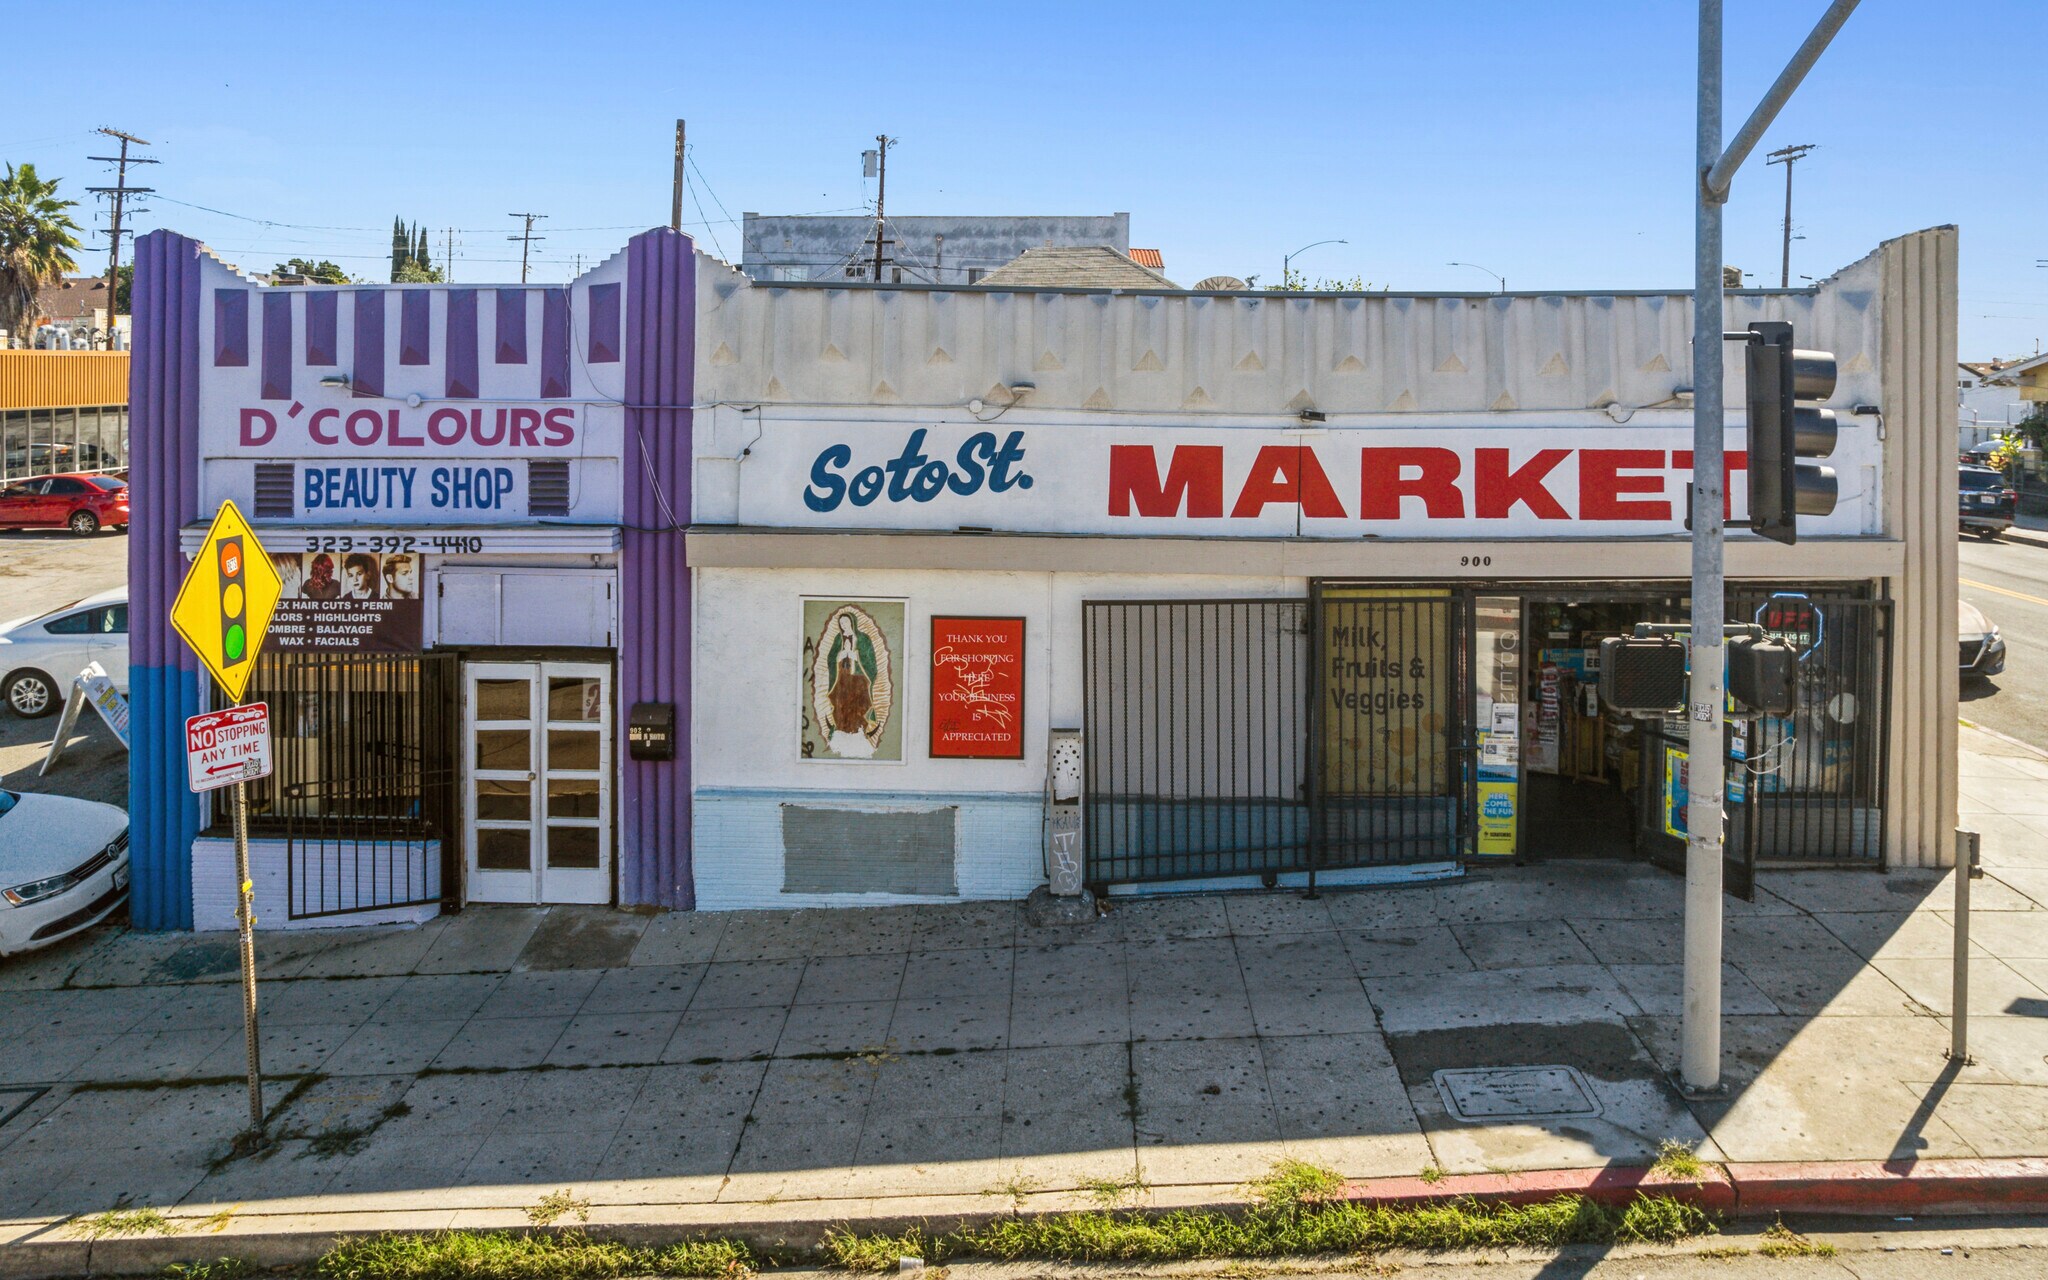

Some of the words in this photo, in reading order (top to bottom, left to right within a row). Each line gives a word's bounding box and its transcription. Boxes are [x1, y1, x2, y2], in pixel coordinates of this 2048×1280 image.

[239, 400, 575, 447] D'COLOURS
[803, 428, 948, 512] Soto
[948, 430, 1033, 496] St.
[304, 467, 417, 509] BEAUTY
[431, 467, 514, 510] SHOP
[305, 536, 484, 553] 323-392-4410
[1460, 556, 1491, 567] 900
[275, 601, 290, 610] EX
[292, 601, 319, 610] HAIR
[322, 601, 351, 610] CUTS
[362, 601, 393, 610] PERM
[270, 613, 303, 622] OLORS
[313, 613, 382, 622] HIGHLIGHTS
[1768, 611, 1811, 629] UFC
[268, 625, 306, 634] OMBRE
[316, 625, 373, 634] BALAYAGE
[279, 637, 304, 646] WAX
[315, 637, 360, 646] FACIALS
[946, 634, 983, 643] THANK
[986, 634, 1007, 643] YOU
[1332, 626, 1386, 651] Milk,
[940, 654, 960, 663] FOR
[962, 654, 1014, 663] SHOPPING
[1587, 657, 1600, 668] EB
[1332, 657, 1402, 678] Fruits
[1409, 657, 1425, 679] &
[938, 692, 967, 701] YOUR
[969, 693, 1016, 701] BUSINESS
[1331, 688, 1425, 715] Veggies
[972, 713, 981, 721] IS
[190, 729, 214, 750] NO
[218, 721, 266, 743] STOPPING
[942, 733, 1011, 741] APPRECIATED
[201, 748, 226, 764] ANY
[231, 741, 260, 757] TIME
[1488, 792, 1508, 800] HERE
[1483, 807, 1497, 815] THE
[1498, 807, 1514, 815] FUN
